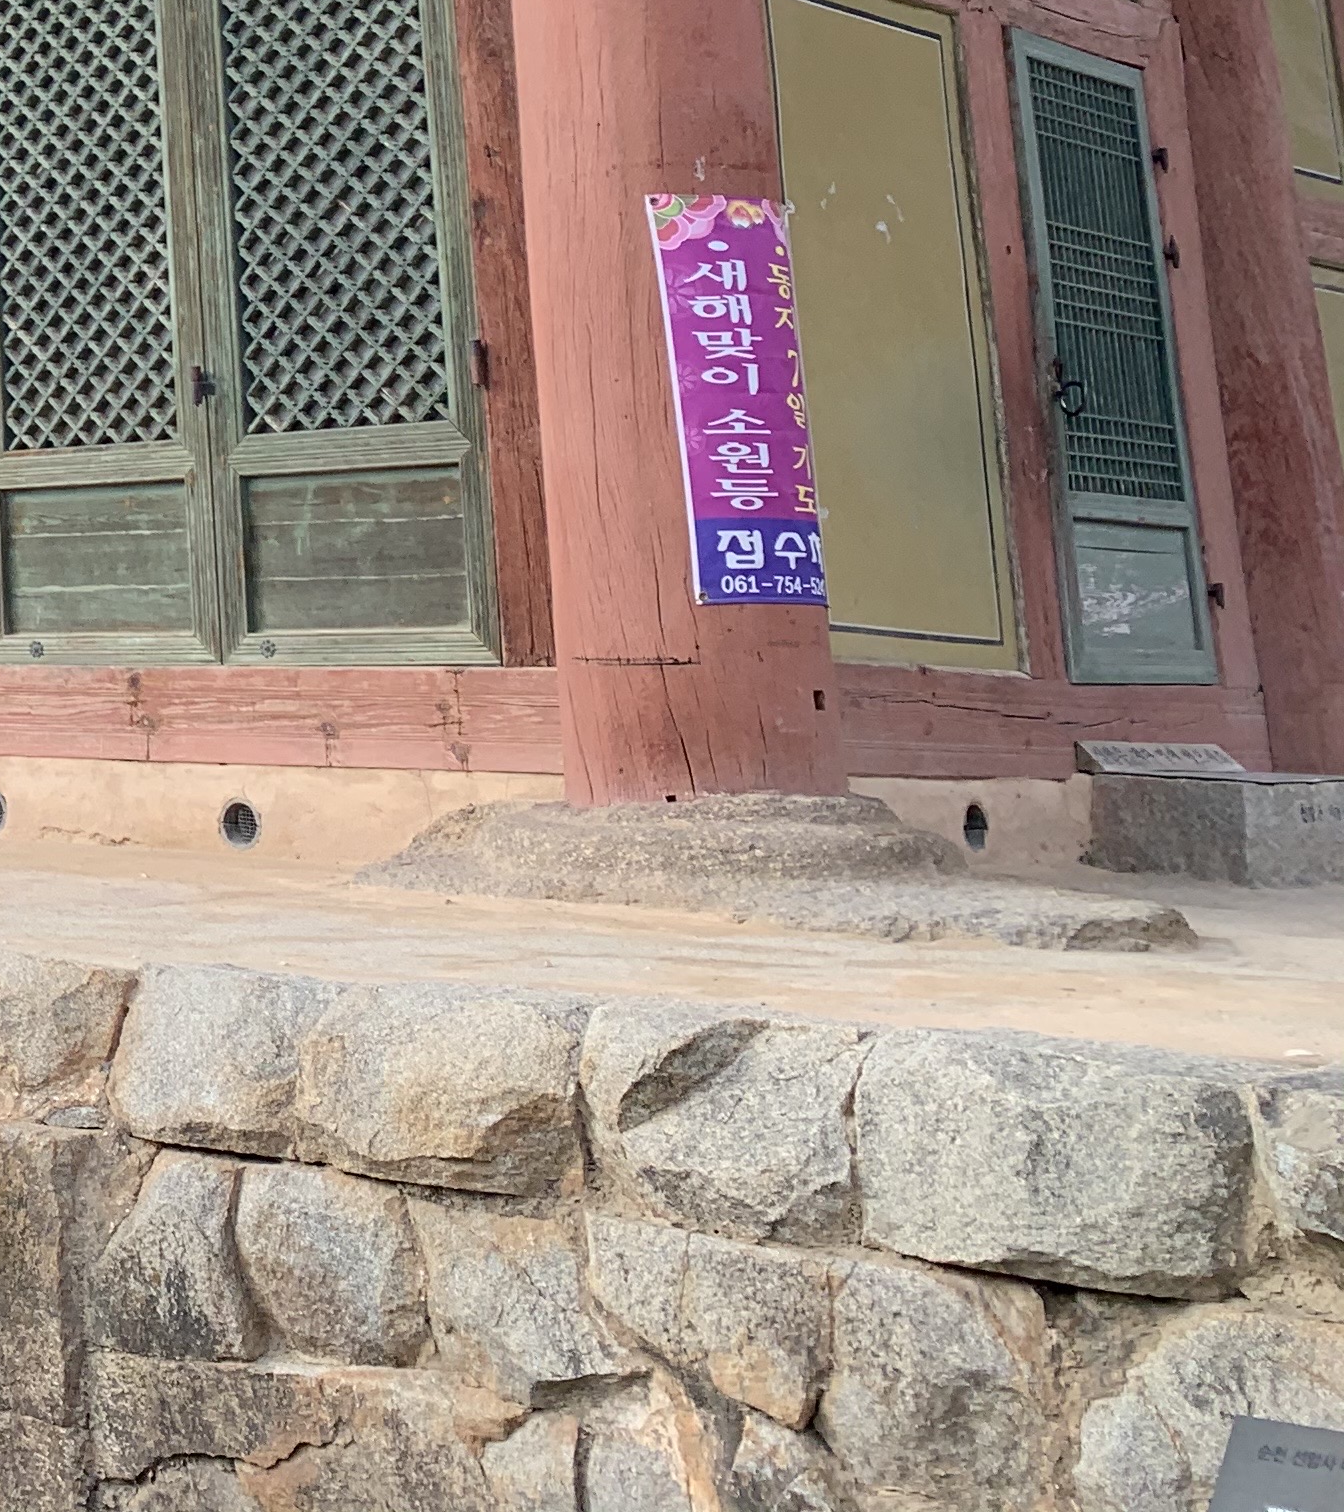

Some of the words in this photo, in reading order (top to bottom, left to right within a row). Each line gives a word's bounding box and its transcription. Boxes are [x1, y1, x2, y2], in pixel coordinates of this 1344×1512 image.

[683, 258, 762, 395] 새해맞이
[703, 409, 779, 510] 소원등
[792, 444, 817, 514] 기도
